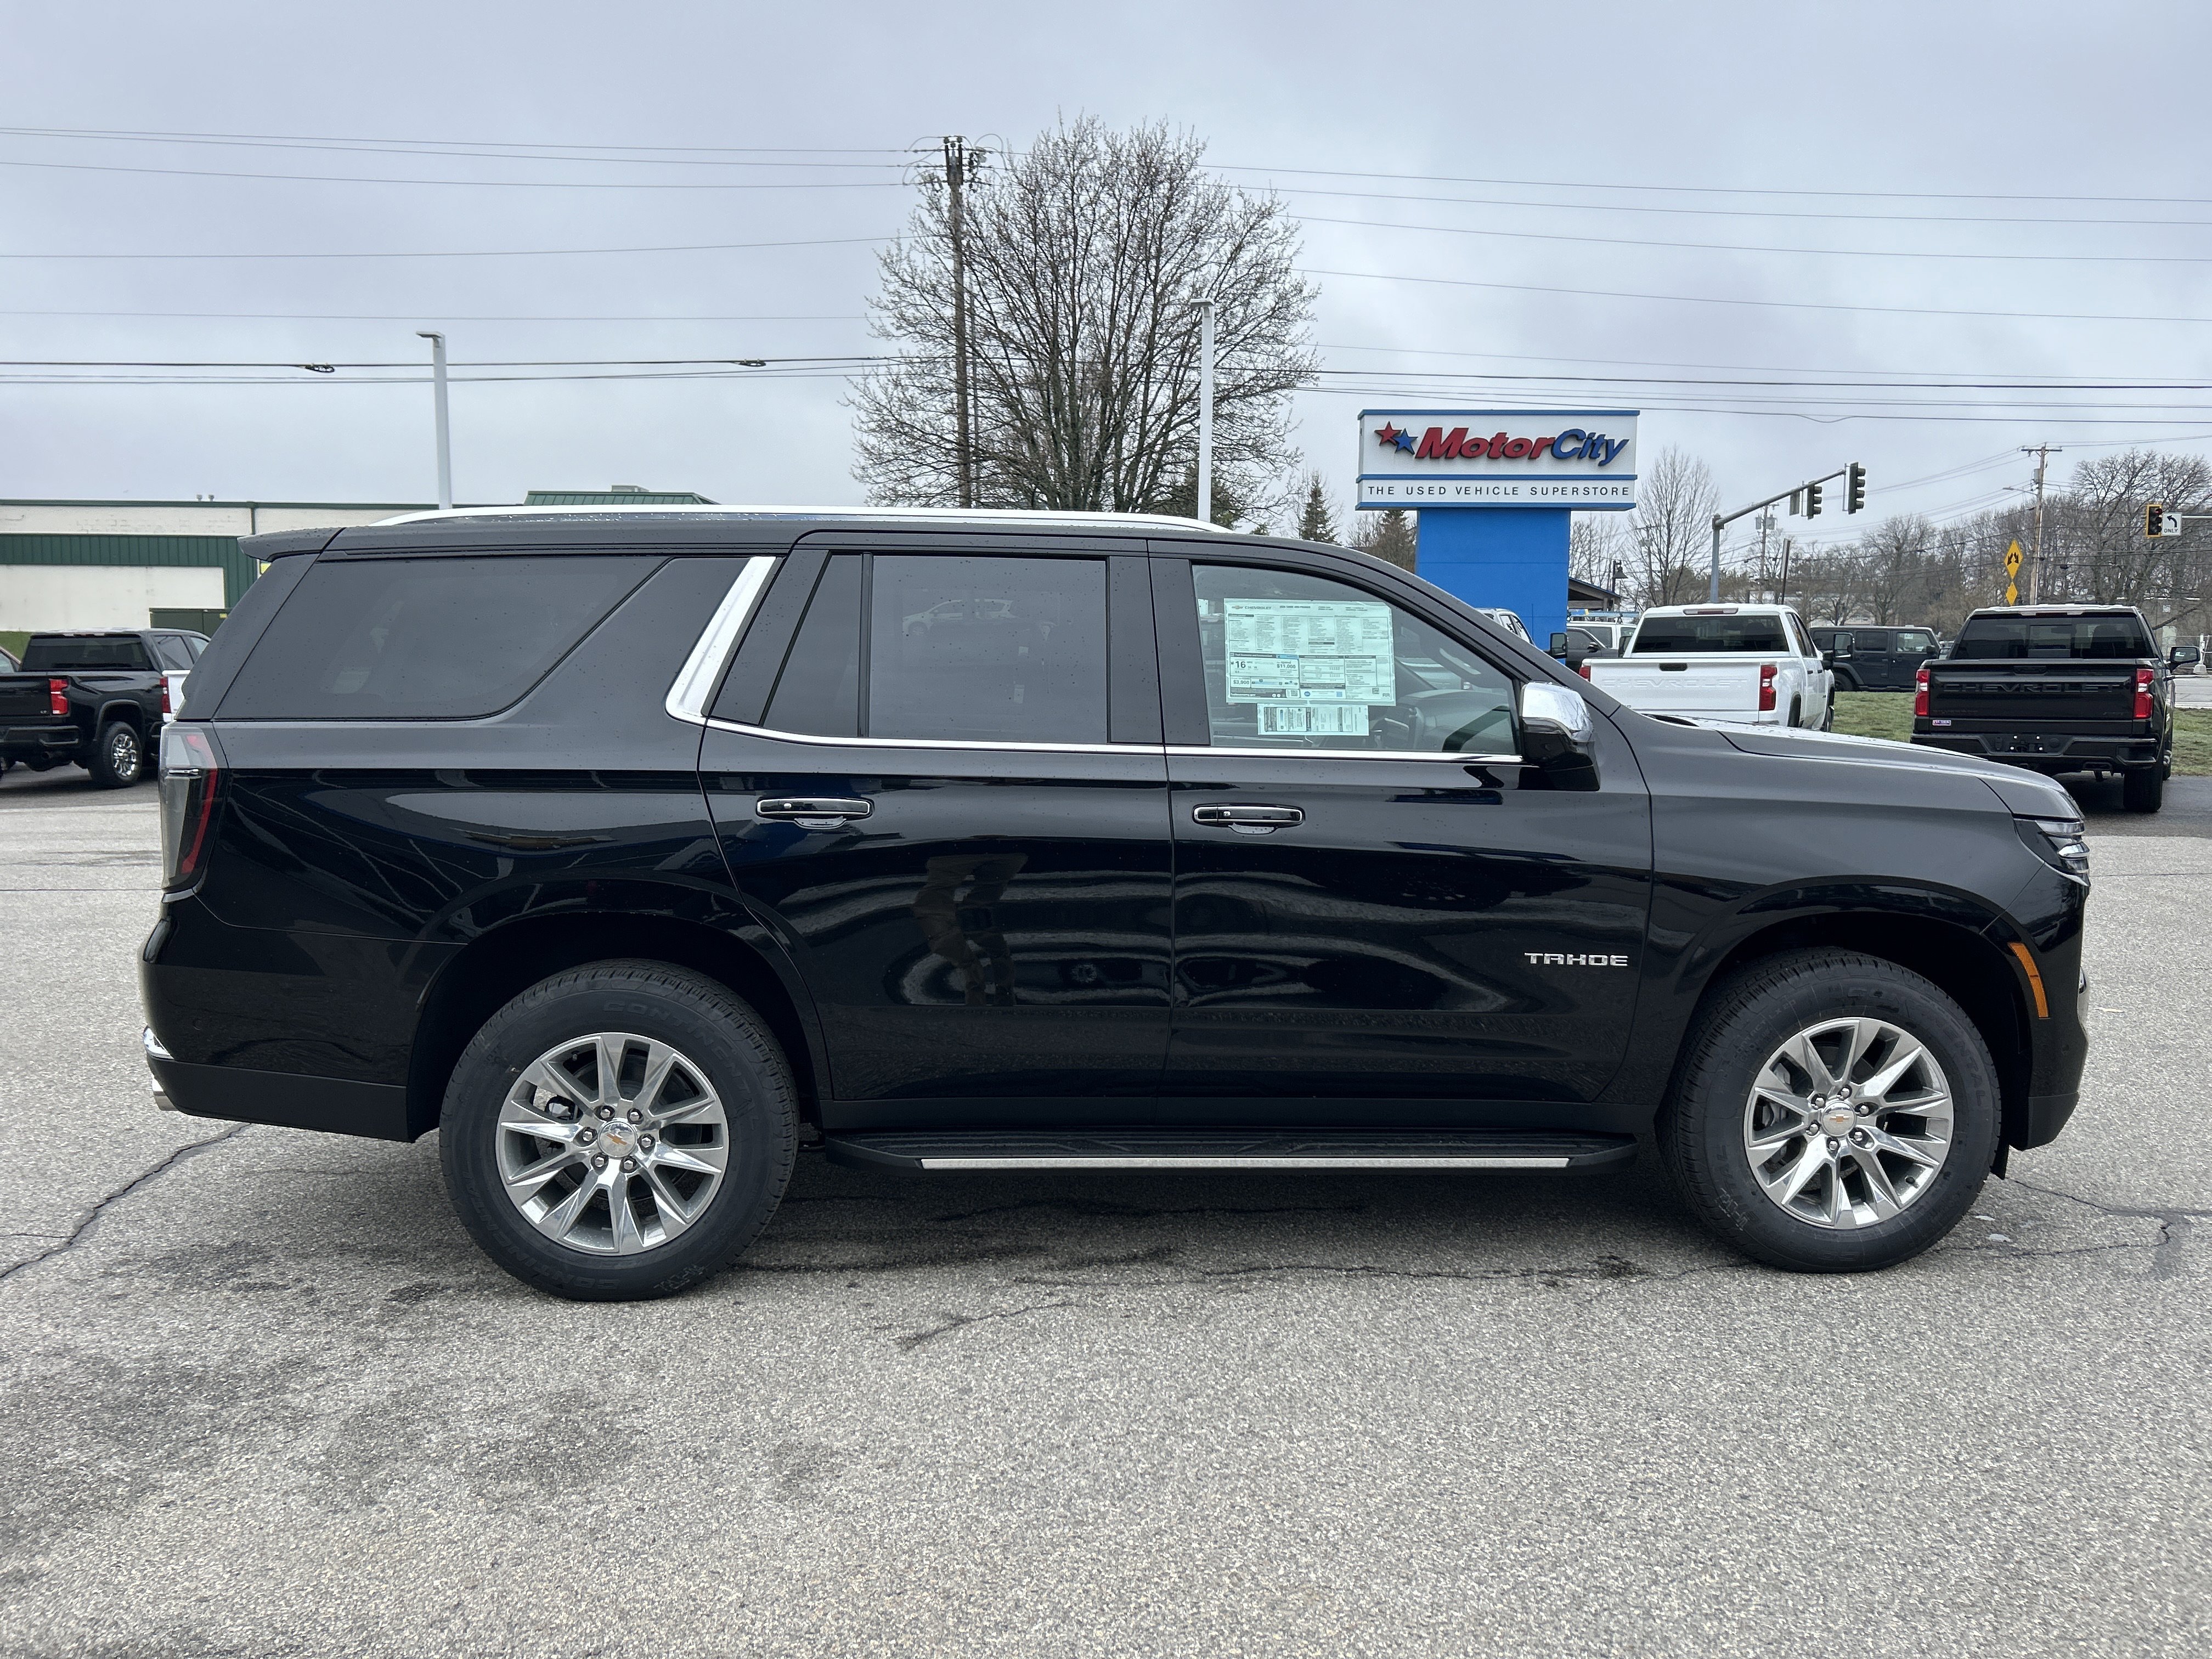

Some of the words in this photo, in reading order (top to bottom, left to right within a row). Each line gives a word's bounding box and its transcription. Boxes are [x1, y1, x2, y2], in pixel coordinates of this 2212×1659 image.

[1414, 427, 1630, 467] MotorCity
[1368, 486, 1395, 495] THE
[1406, 486, 1446, 495] USED
[1455, 486, 1519, 495] VEHICLE
[1530, 486, 1629, 496] SUPERSTORE
[1235, 661, 1246, 669] 16
[1600, 678, 1748, 689] CHEVROLET
[1943, 683, 2120, 693] CHEVROLET
[1524, 952, 1628, 966] TAHOE
